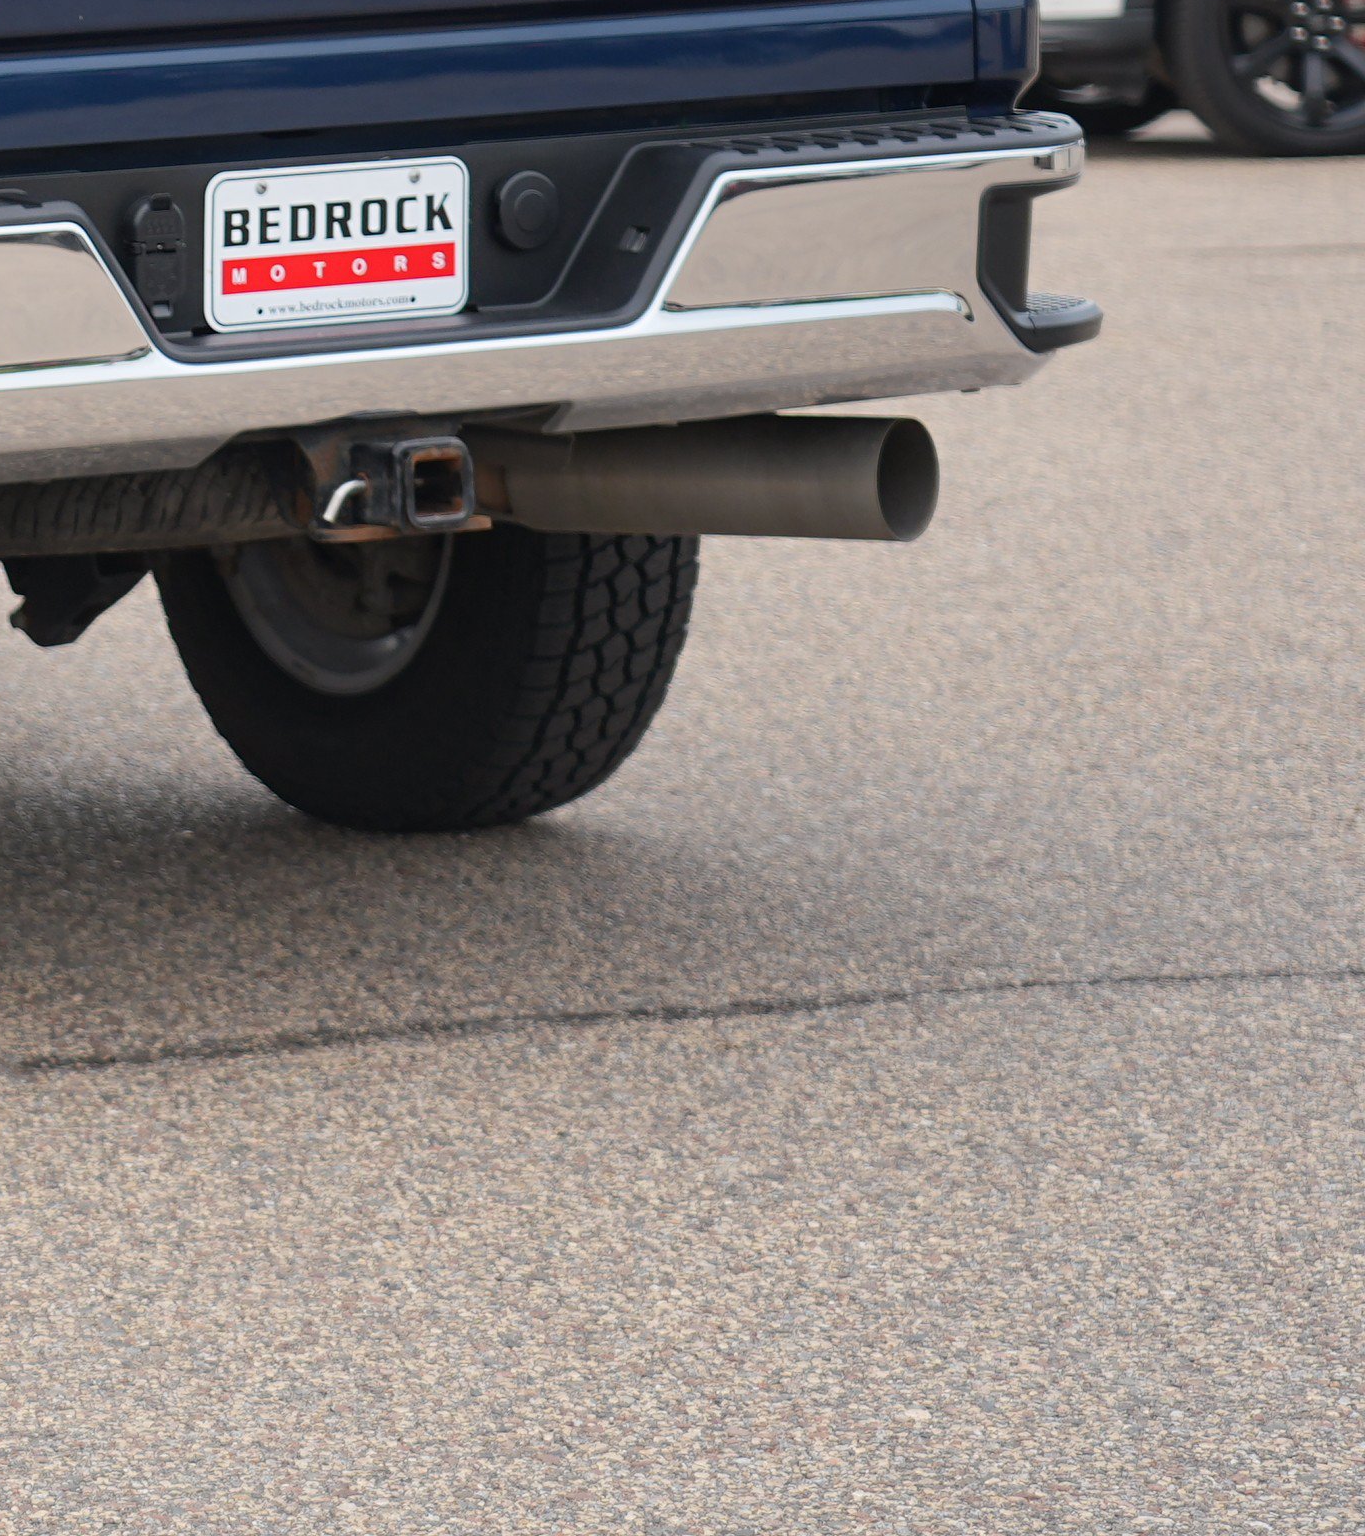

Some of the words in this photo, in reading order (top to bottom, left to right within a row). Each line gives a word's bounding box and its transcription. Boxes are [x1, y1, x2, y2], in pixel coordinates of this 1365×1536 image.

[223, 193, 453, 247] BEDROCK
[231, 251, 446, 285] MOTORS
[267, 296, 410, 315] www.bedrockmotors.com
